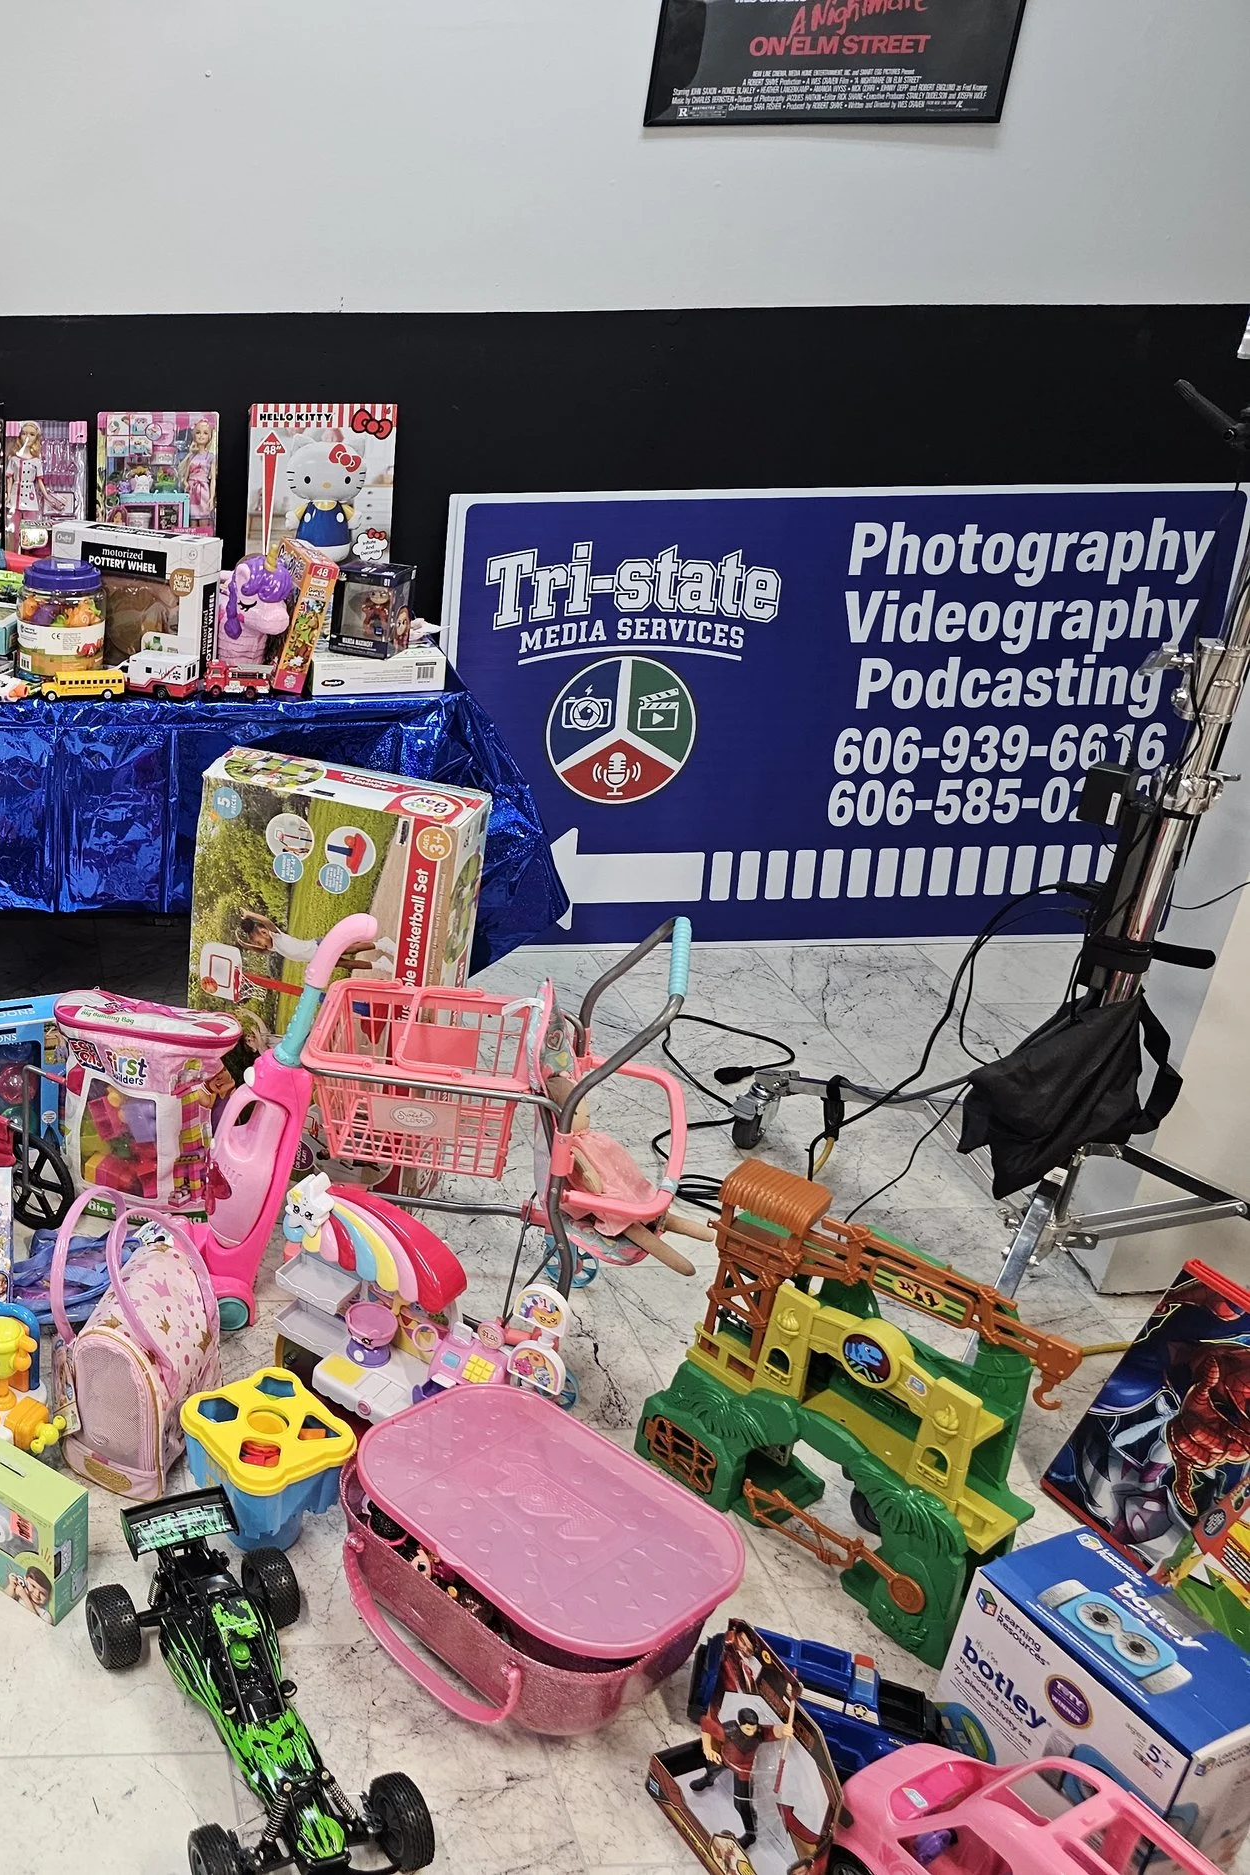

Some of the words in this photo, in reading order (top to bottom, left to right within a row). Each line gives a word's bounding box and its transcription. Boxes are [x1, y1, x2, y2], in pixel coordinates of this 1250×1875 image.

[750, 36, 787, 57] ON
[790, 36, 840, 56] ELM
[842, 35, 931, 55] STREET
[259, 412, 293, 422] HELLO
[296, 412, 332, 422] KITTY
[88, 555, 126, 569] POTTERY
[126, 559, 158, 574] WHEEL
[102, 547, 144, 560] motorized
[316, 567, 329, 578] 48
[847, 517, 1216, 587] Photography
[485, 541, 783, 630] Tri-state
[519, 618, 607, 655] MEDIA
[616, 619, 745, 651] SERVICES
[845, 586, 1200, 655] Videography
[855, 657, 1162, 718] Podcasting
[833, 722, 1168, 776] 606-939-6616
[827, 775, 1154, 827] 606-585-0
[413, 867, 429, 890] Set
[405, 891, 426, 973] Basketball
[121, 1016, 135, 1025] Bag
[87, 1200, 109, 1217] Big
[996, 1615, 1050, 1667] Resources
[998, 1606, 1042, 1653] Learning
[1113, 1581, 1210, 1652] botley
[953, 1663, 986, 1701] 77-piece
[986, 1699, 1018, 1732] activity
[1018, 1731, 1032, 1746] set
[959, 1656, 971, 1672] the
[972, 1670, 999, 1701] coding
[1000, 1698, 1024, 1724] robot
[961, 1635, 1047, 1730] botley
[1051, 1694, 1082, 1724] WINNER
[1146, 1743, 1173, 1770] 5+
